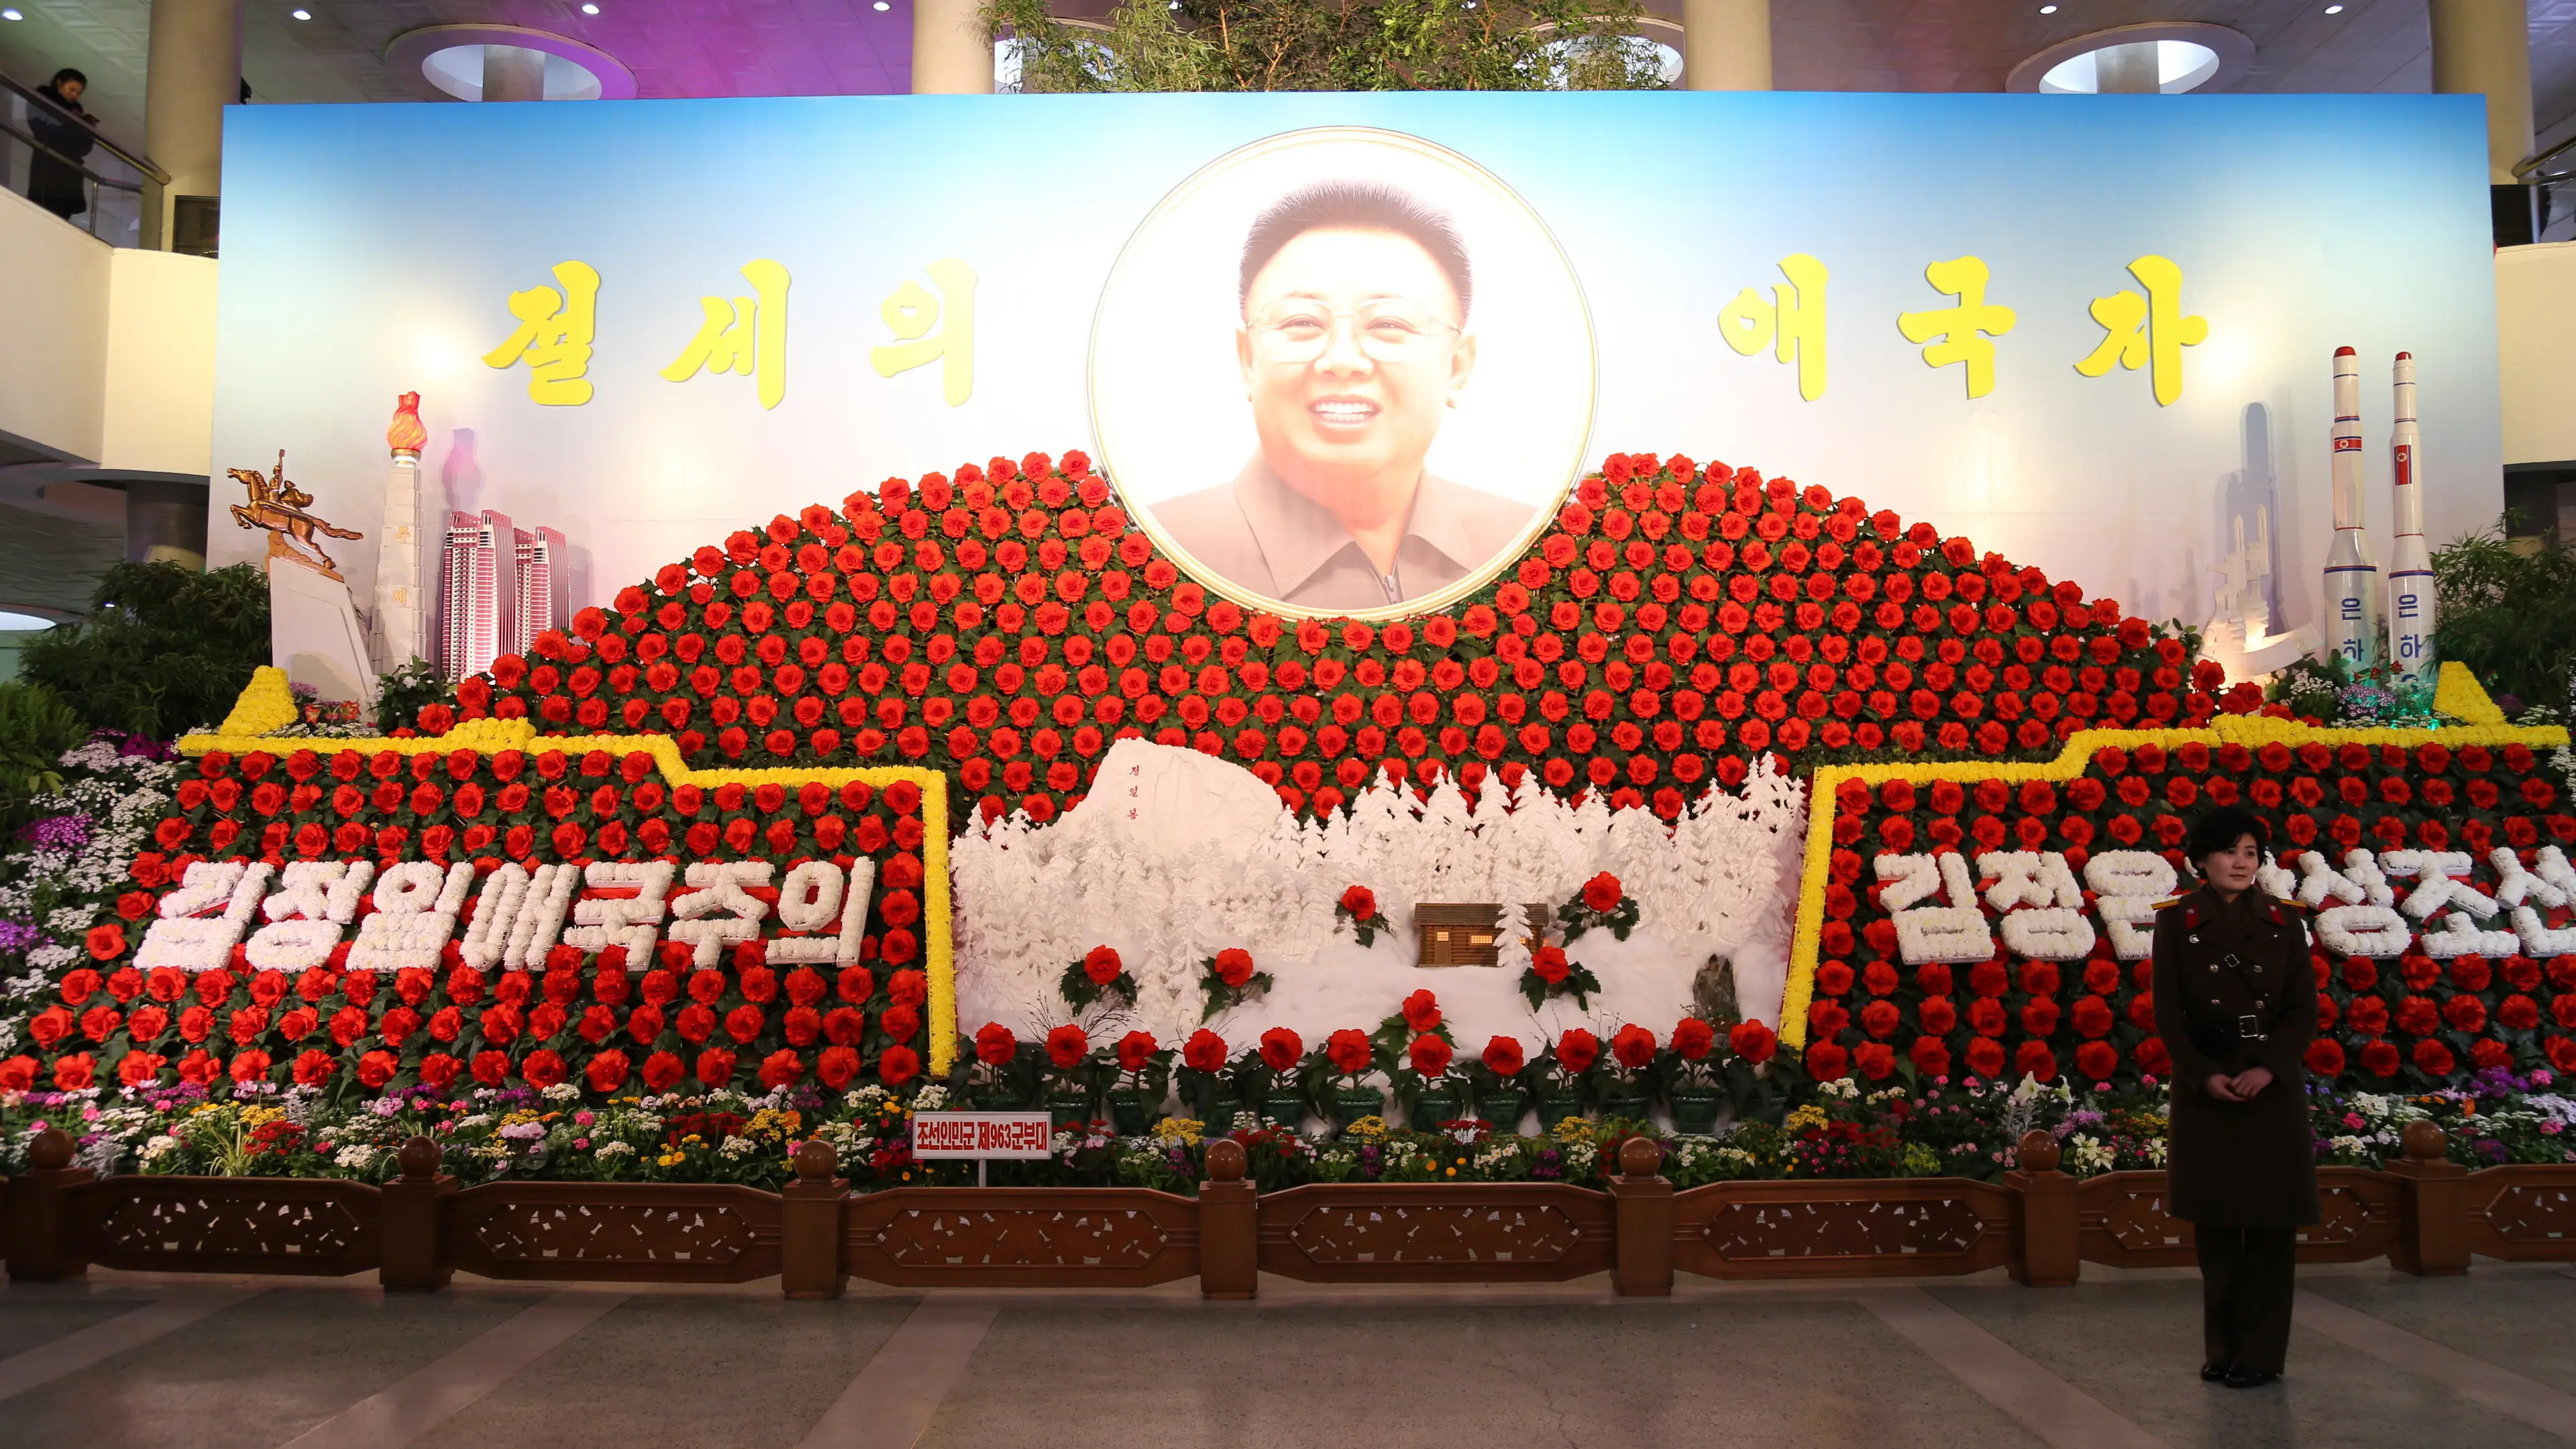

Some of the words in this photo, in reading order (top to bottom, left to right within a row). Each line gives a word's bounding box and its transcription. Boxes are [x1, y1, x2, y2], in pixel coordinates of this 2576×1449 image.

[1717, 253, 2209, 407] 애국자
[1127, 765, 1140, 820] 정일봉
[917, 1122, 975, 1150] 조선인민군
[977, 1122, 1047, 1150] 제963군부대
